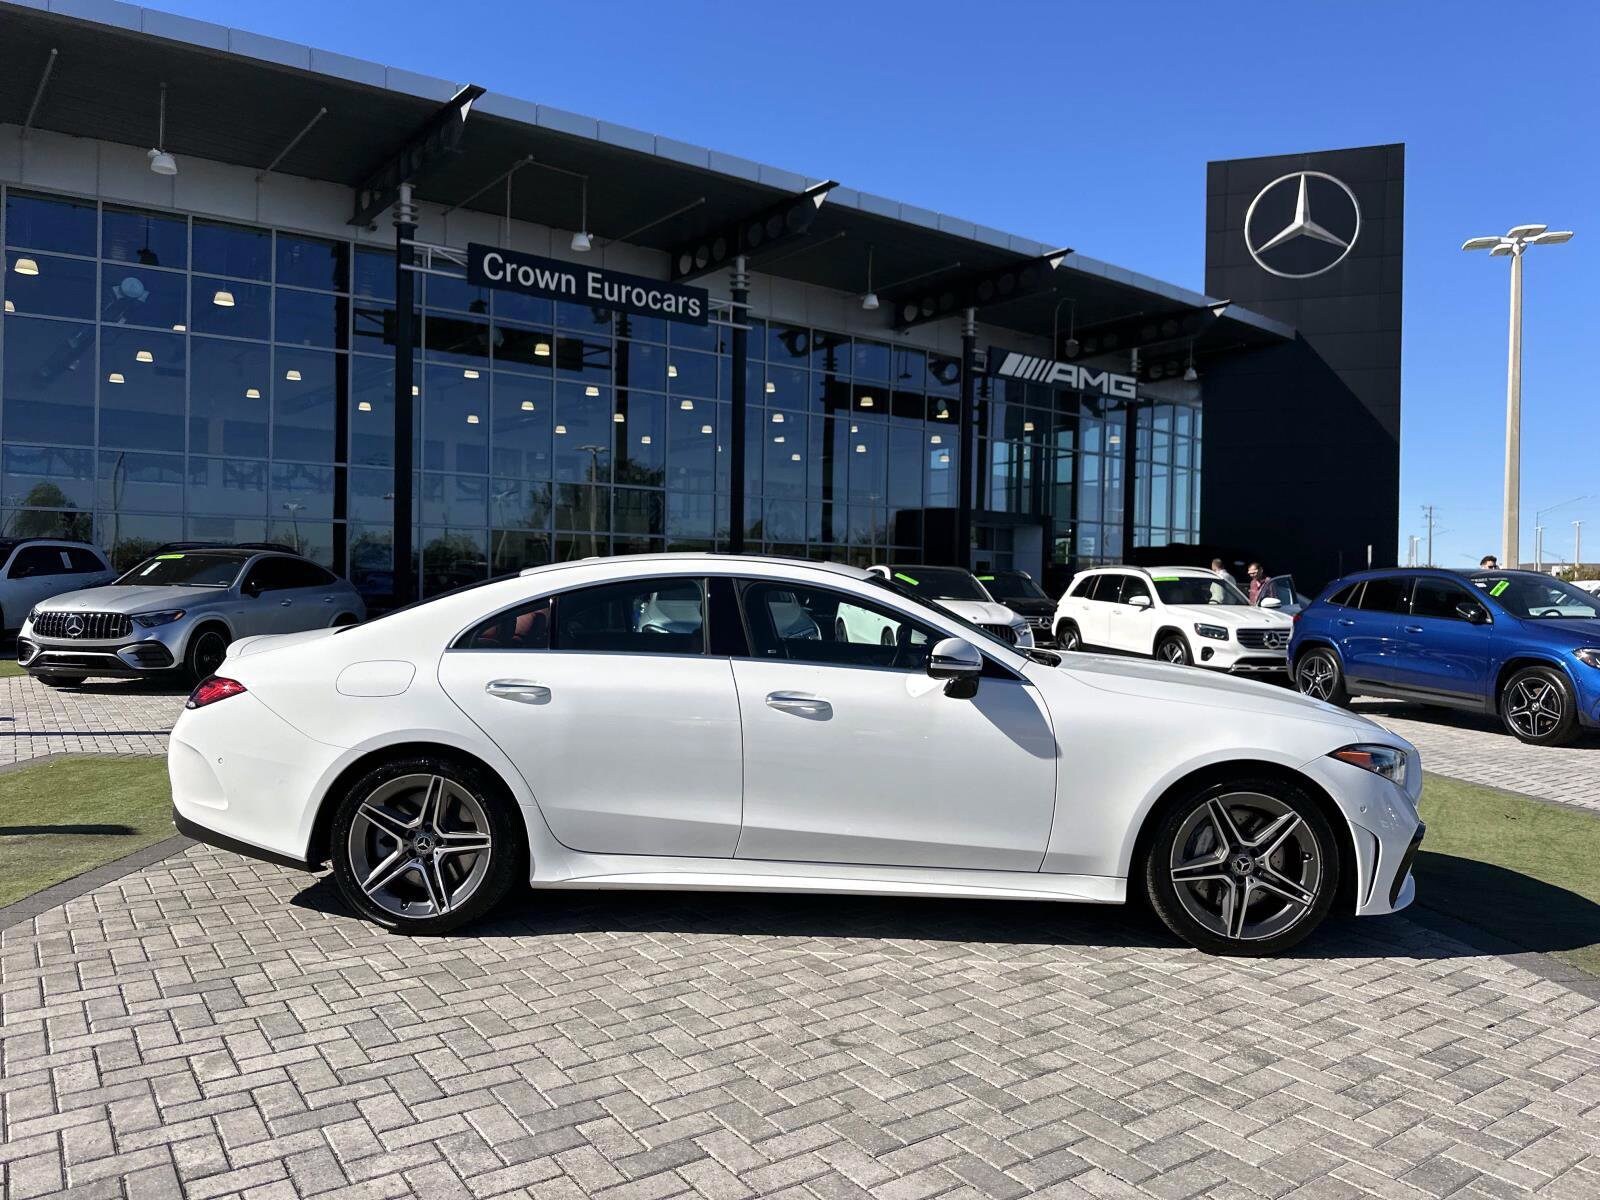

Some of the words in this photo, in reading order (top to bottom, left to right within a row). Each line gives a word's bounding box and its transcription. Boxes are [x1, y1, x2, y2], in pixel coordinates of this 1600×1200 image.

[482, 252, 577, 296] Crown
[587, 271, 701, 318] Eurocars
[1045, 361, 1137, 400] AMG
